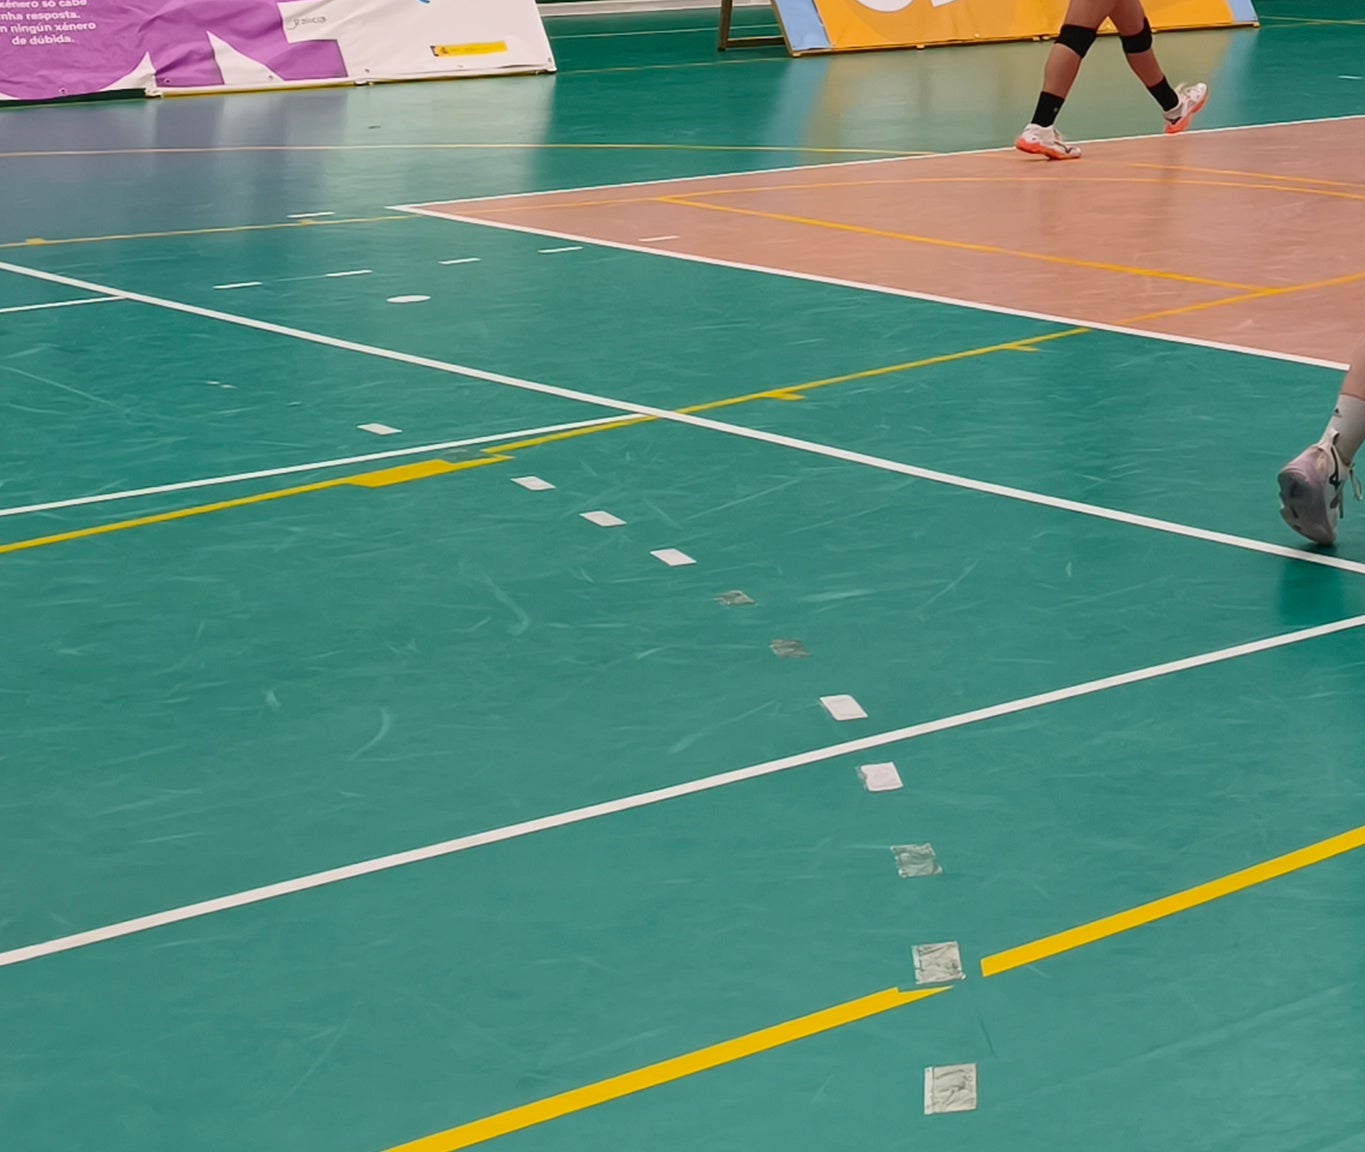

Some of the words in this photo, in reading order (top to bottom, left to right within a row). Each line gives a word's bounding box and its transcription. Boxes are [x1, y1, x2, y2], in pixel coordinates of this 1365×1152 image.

[10, 22, 52, 34] ningún
[55, 22, 96, 31] xénero
[11, 36, 27, 45] de
